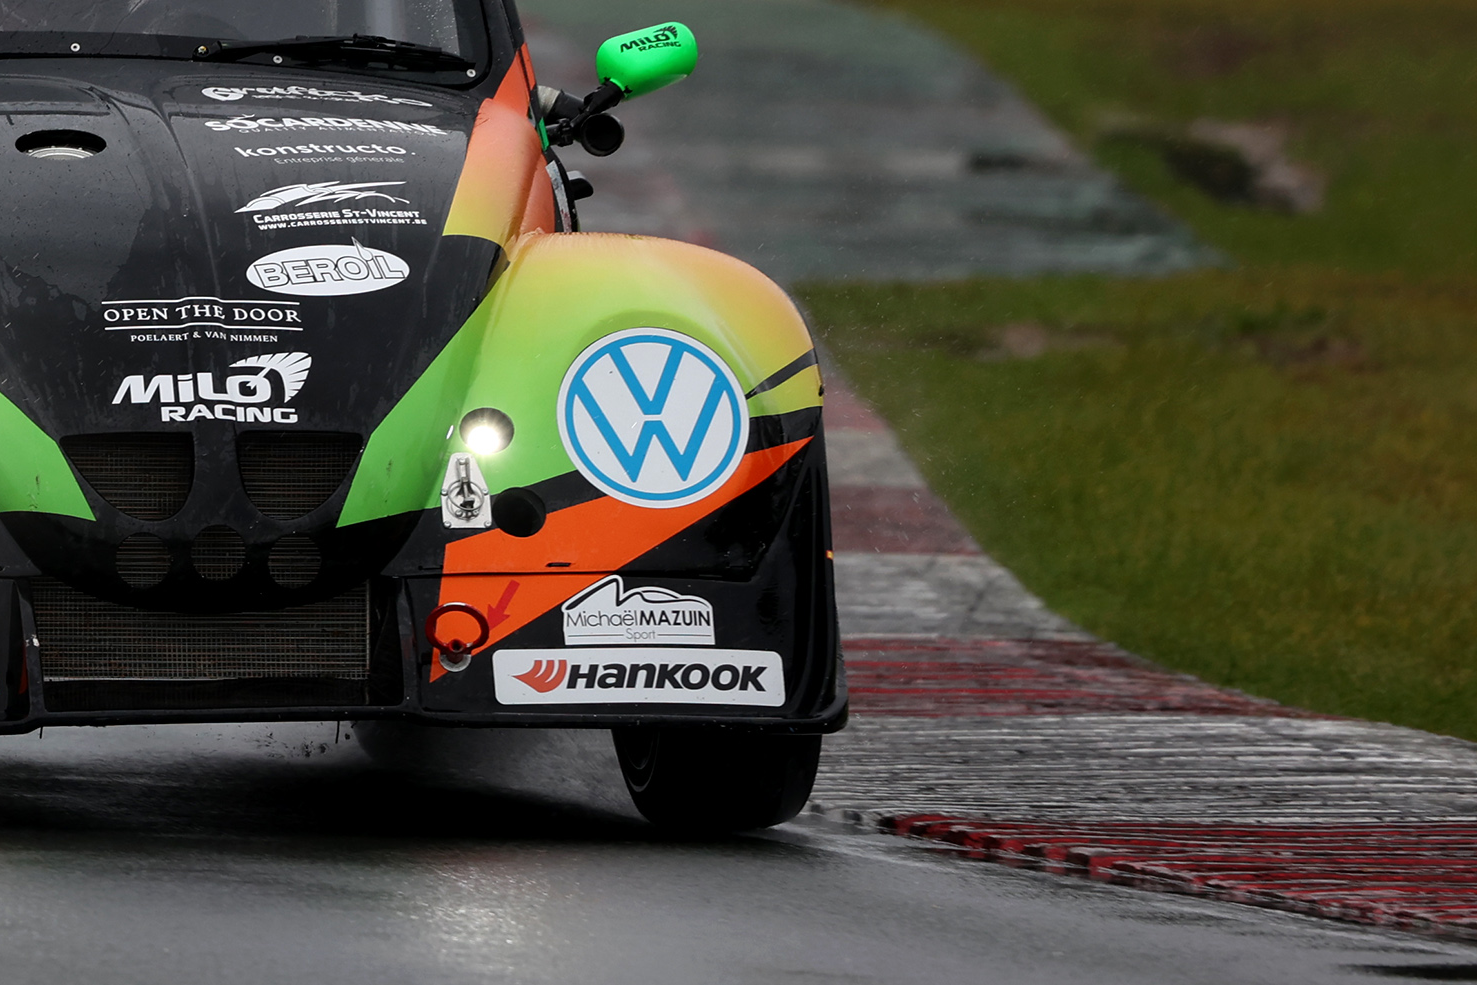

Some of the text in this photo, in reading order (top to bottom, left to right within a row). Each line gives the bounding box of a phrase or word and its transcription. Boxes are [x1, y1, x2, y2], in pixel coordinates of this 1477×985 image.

[638, 41, 681, 52] RACING
[205, 116, 447, 135] SOCARDENNE
[103, 304, 302, 323] OPEN THE DOOR
[130, 330, 278, 343] POELAERT & VAN NIMMEN
[161, 404, 299, 424] RACING
[639, 610, 711, 626] MAZUIN
[625, 628, 656, 642] Sport
